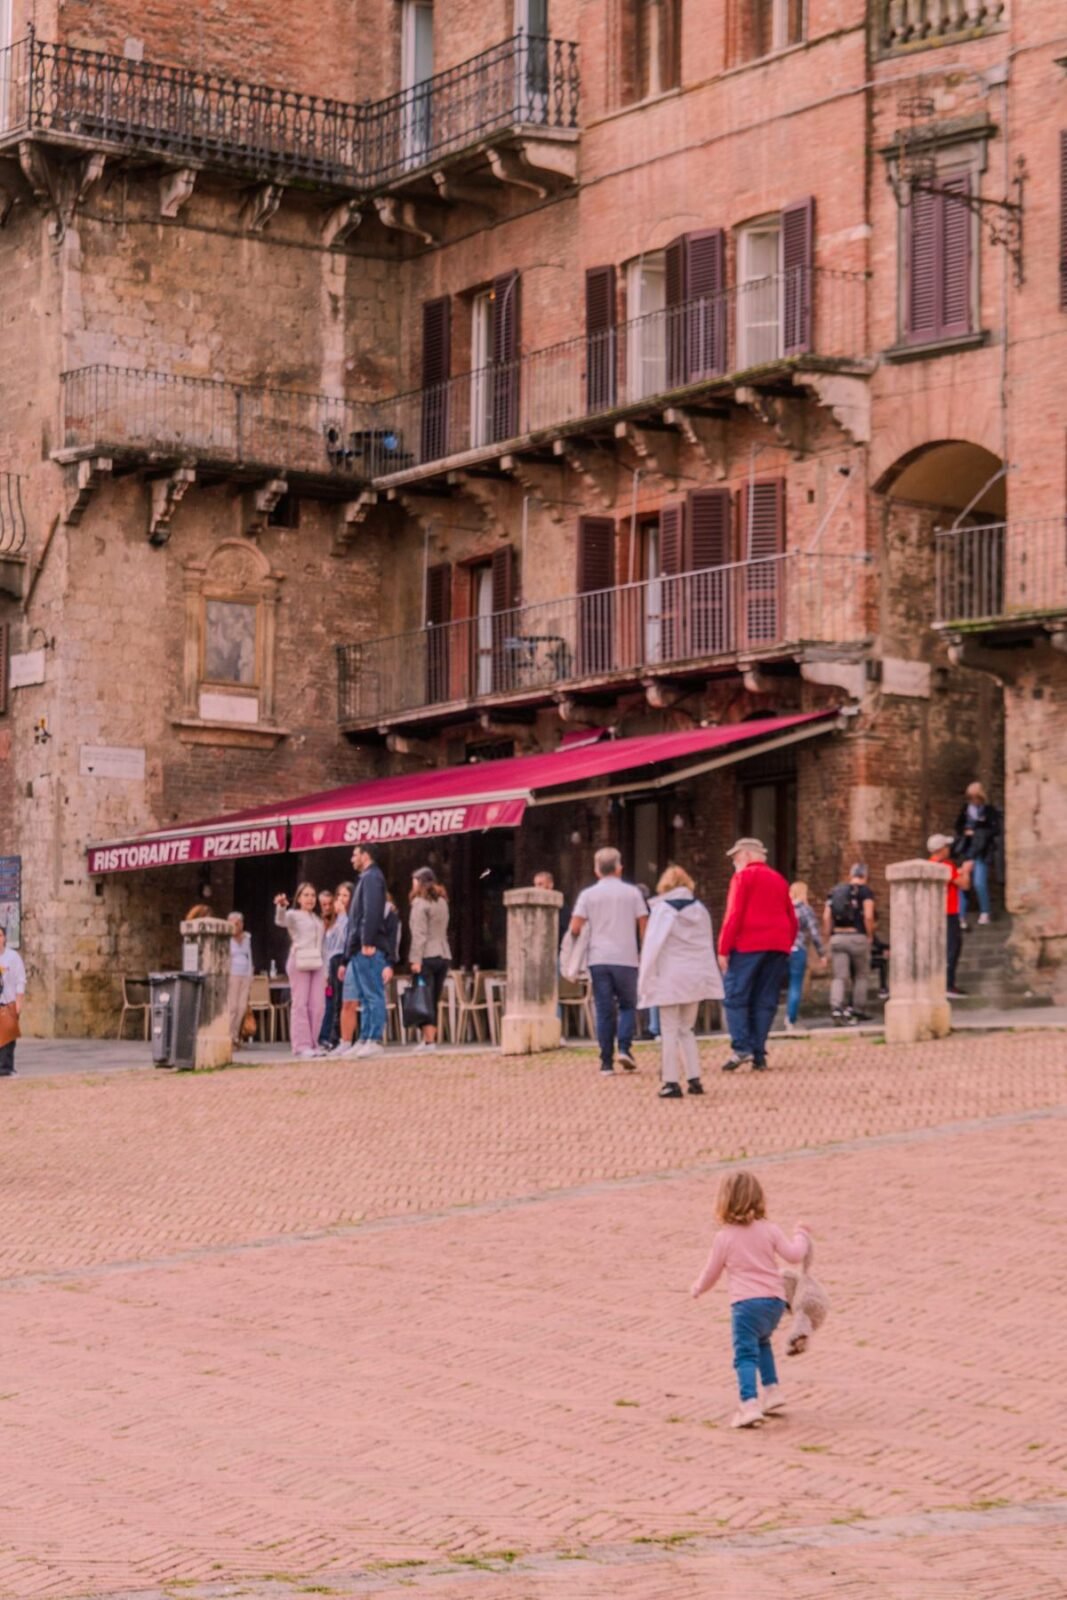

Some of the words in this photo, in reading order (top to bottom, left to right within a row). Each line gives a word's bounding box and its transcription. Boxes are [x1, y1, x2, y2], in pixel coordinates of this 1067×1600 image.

[343, 808, 466, 842] SPADAFORTE
[94, 840, 190, 871] RISTORANTE
[203, 830, 279, 858] PIZZERIA
